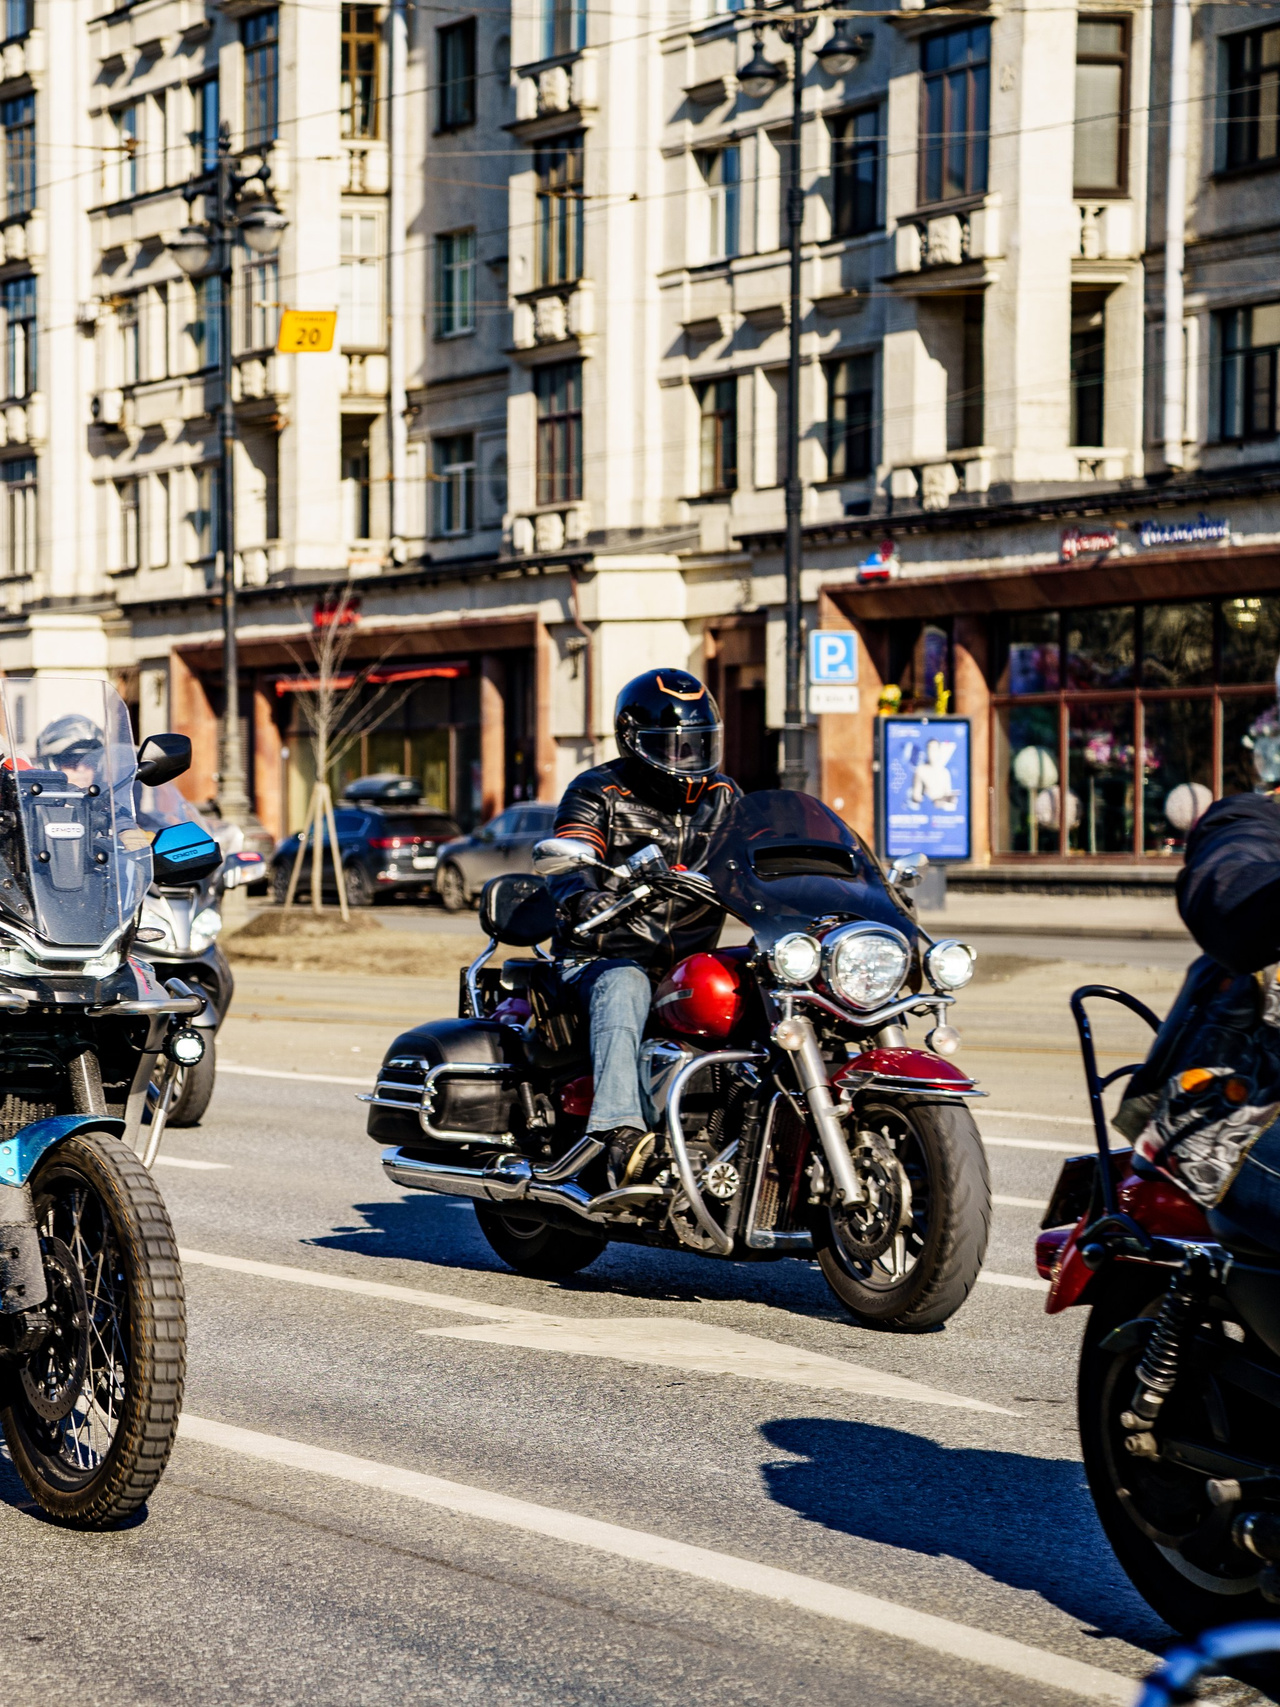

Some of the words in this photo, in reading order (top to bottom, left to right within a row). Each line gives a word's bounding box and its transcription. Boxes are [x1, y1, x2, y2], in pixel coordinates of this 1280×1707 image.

[296, 327, 321, 345] 20
[819, 636, 847, 677] P
[172, 849, 198, 860] CFMOTO
